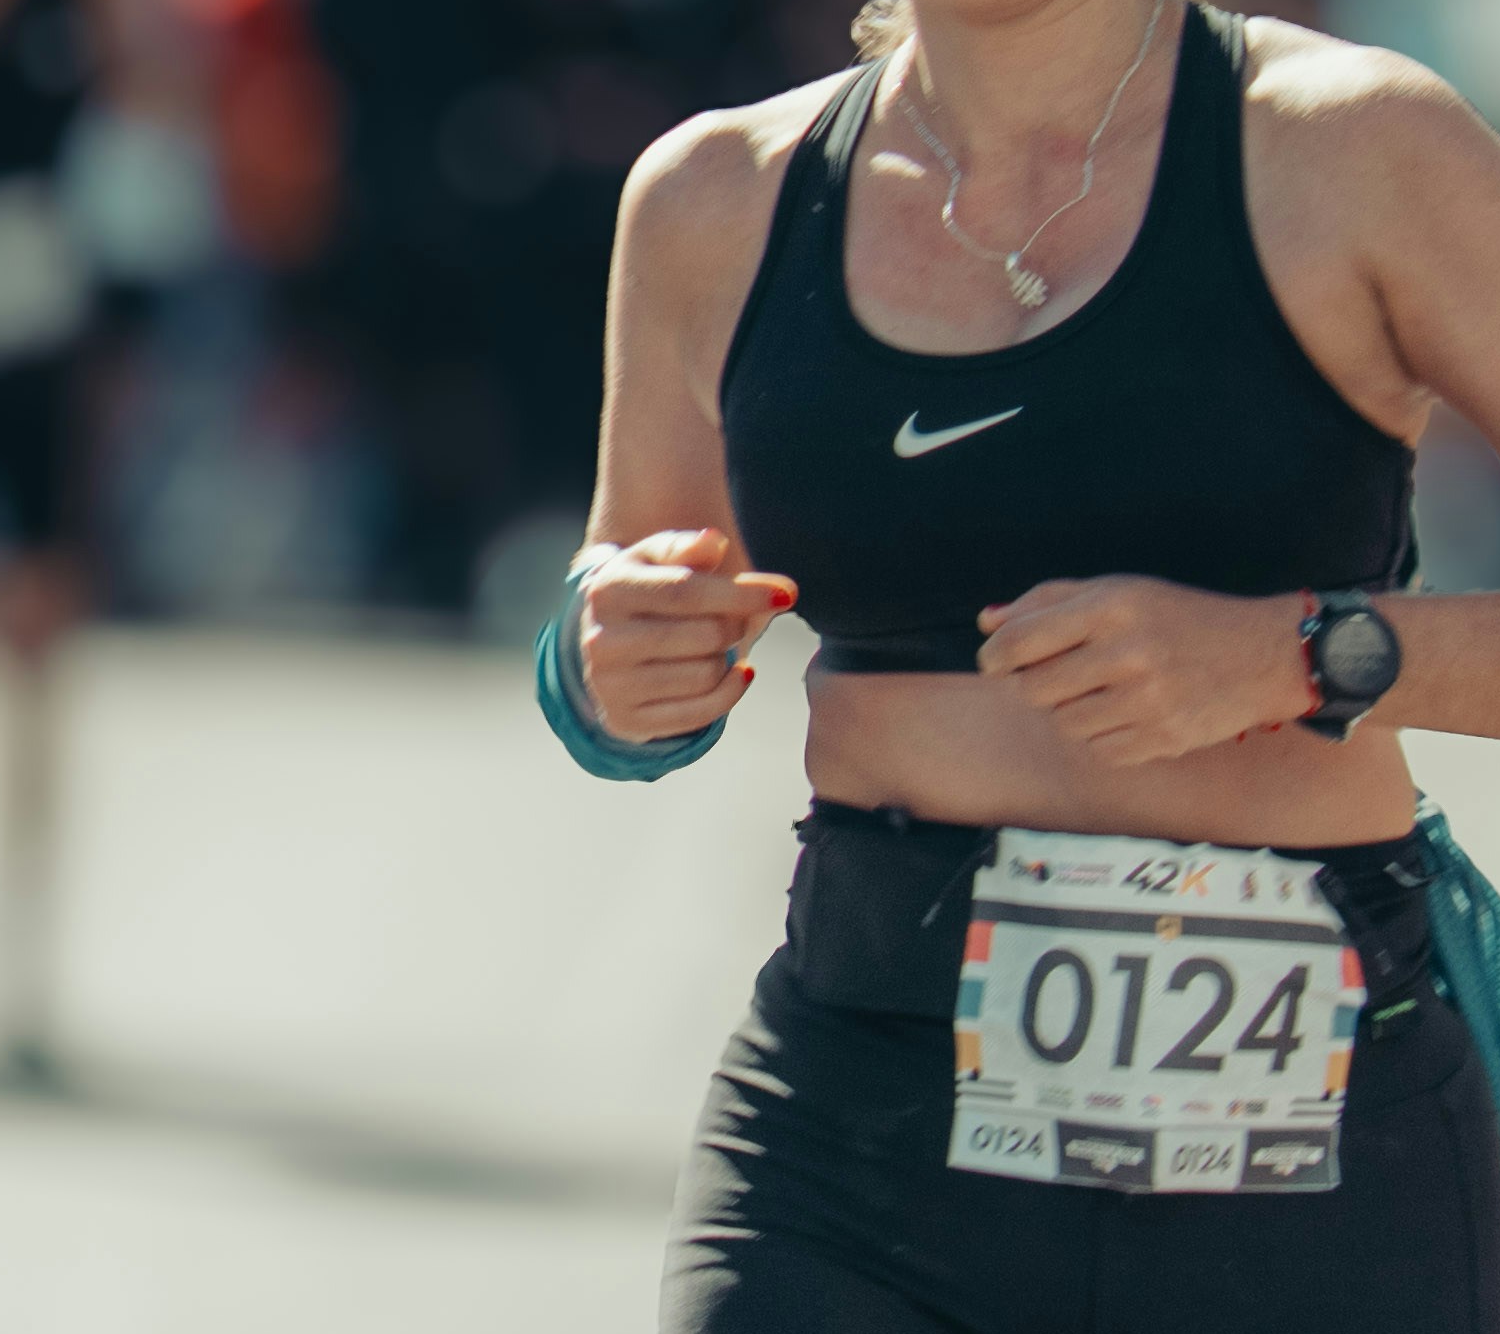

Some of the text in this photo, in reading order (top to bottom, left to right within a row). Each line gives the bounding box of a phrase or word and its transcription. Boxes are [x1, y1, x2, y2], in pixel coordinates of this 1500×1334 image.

[1124, 857, 1218, 897] 42K
[1022, 948, 1309, 1073] 0124
[970, 1123, 1044, 1160] 0124
[1173, 1143, 1234, 1175] 0124
